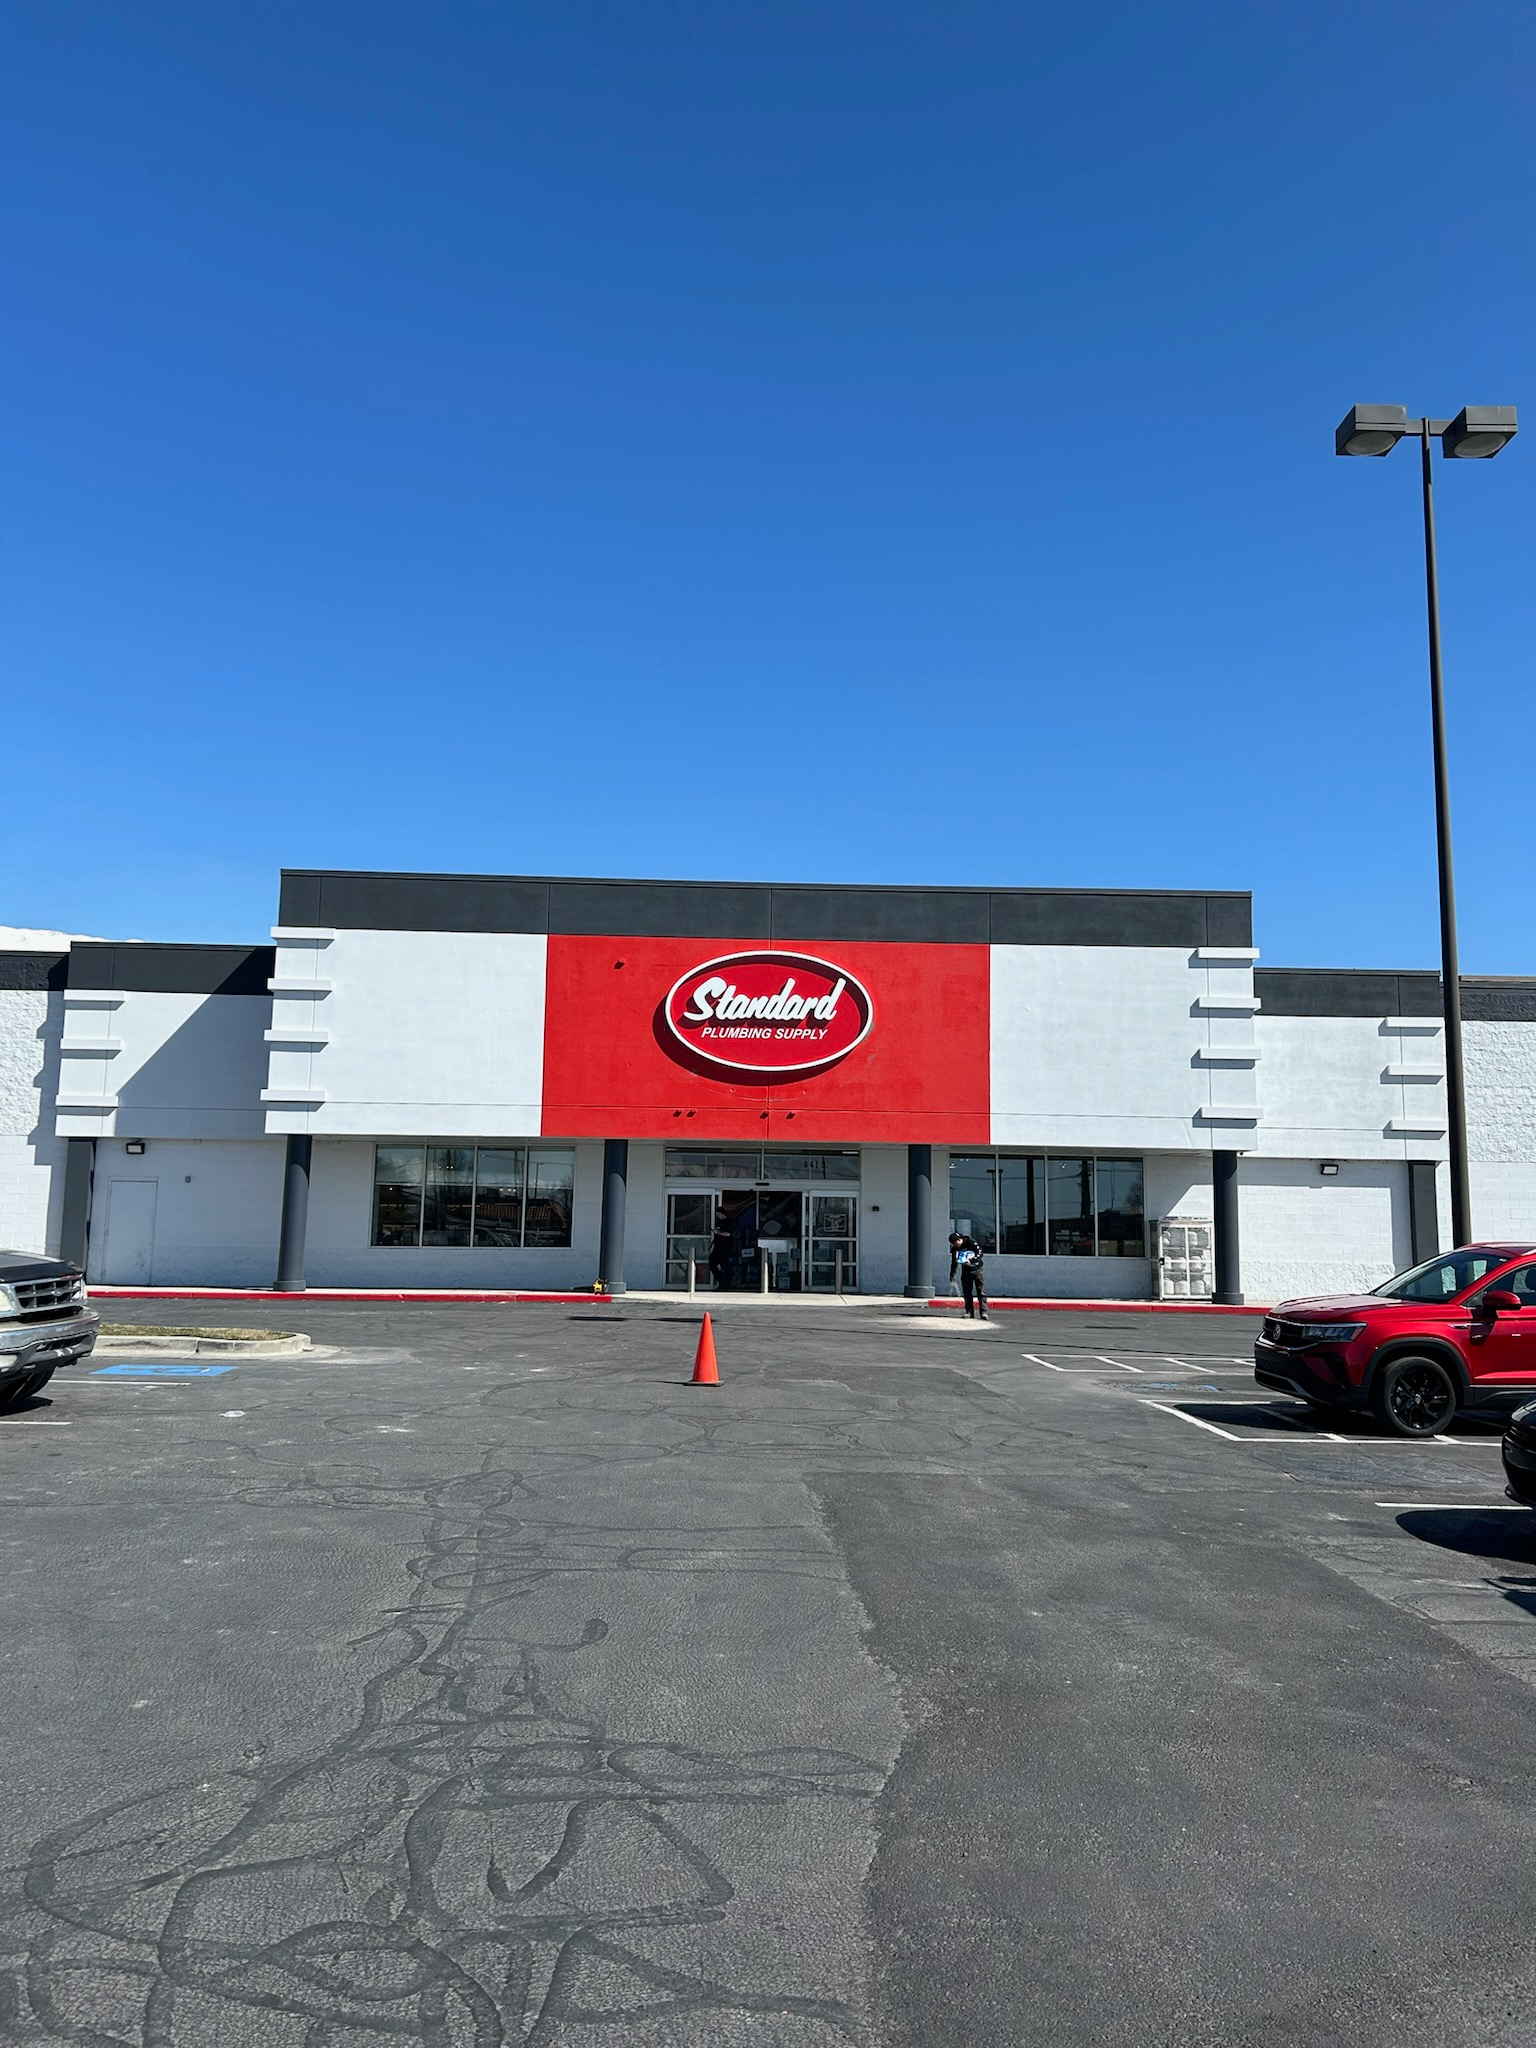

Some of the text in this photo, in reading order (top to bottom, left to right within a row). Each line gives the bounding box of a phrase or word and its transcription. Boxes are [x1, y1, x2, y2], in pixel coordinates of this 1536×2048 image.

[683, 976, 846, 1021] Standard
[701, 1027, 828, 1040] PLUMBING SUPPLY
